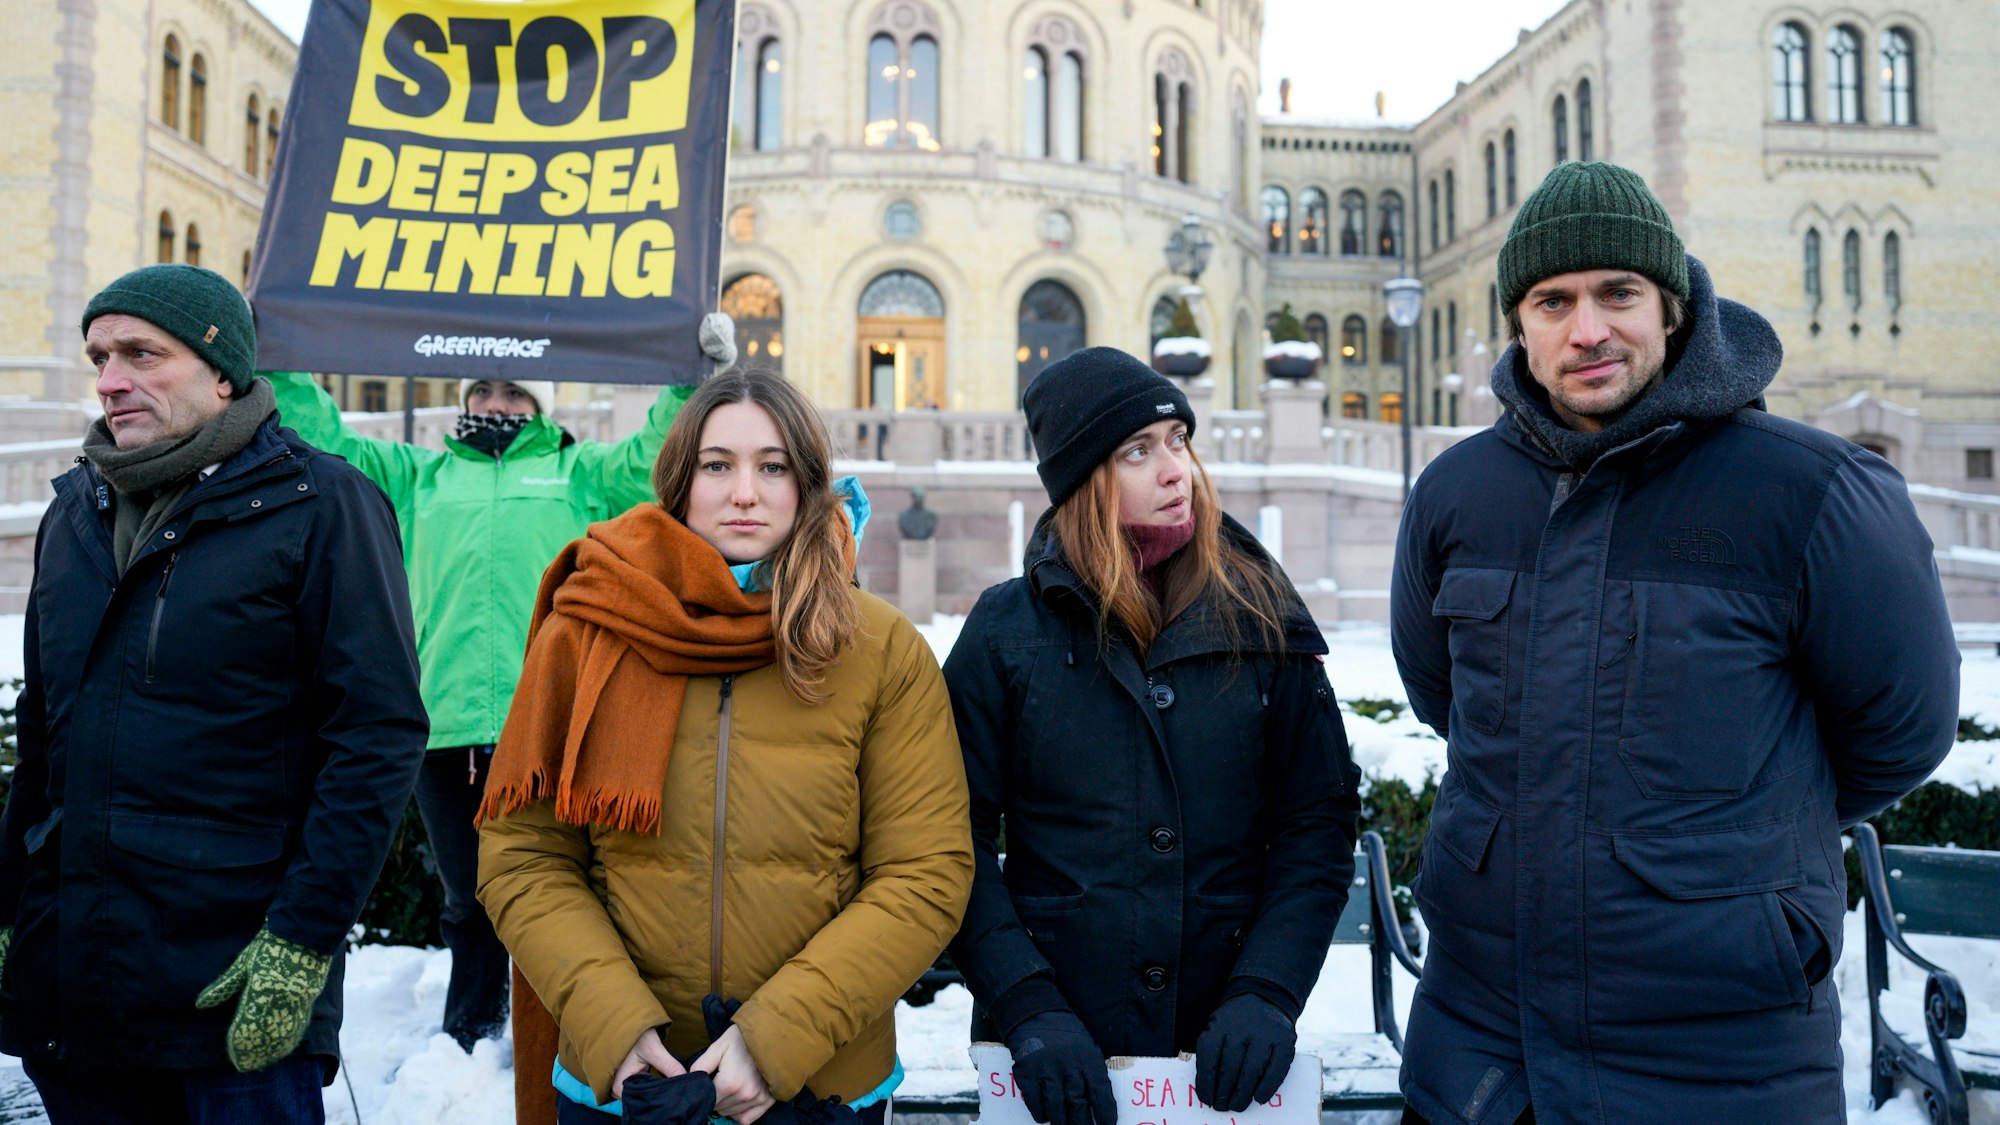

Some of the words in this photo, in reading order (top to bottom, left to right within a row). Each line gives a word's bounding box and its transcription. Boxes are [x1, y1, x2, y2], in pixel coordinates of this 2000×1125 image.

[375, 12, 678, 127] STOP
[331, 137, 538, 215] DEEP
[540, 143, 679, 216] SEA
[309, 211, 676, 299] MINING
[414, 334, 551, 358] GREENPEACE
[1656, 537, 1712, 550] NORTH
[1680, 526, 1712, 538] THE
[1671, 550, 1711, 562] FACE
[1131, 1077, 1176, 1108] SEA
